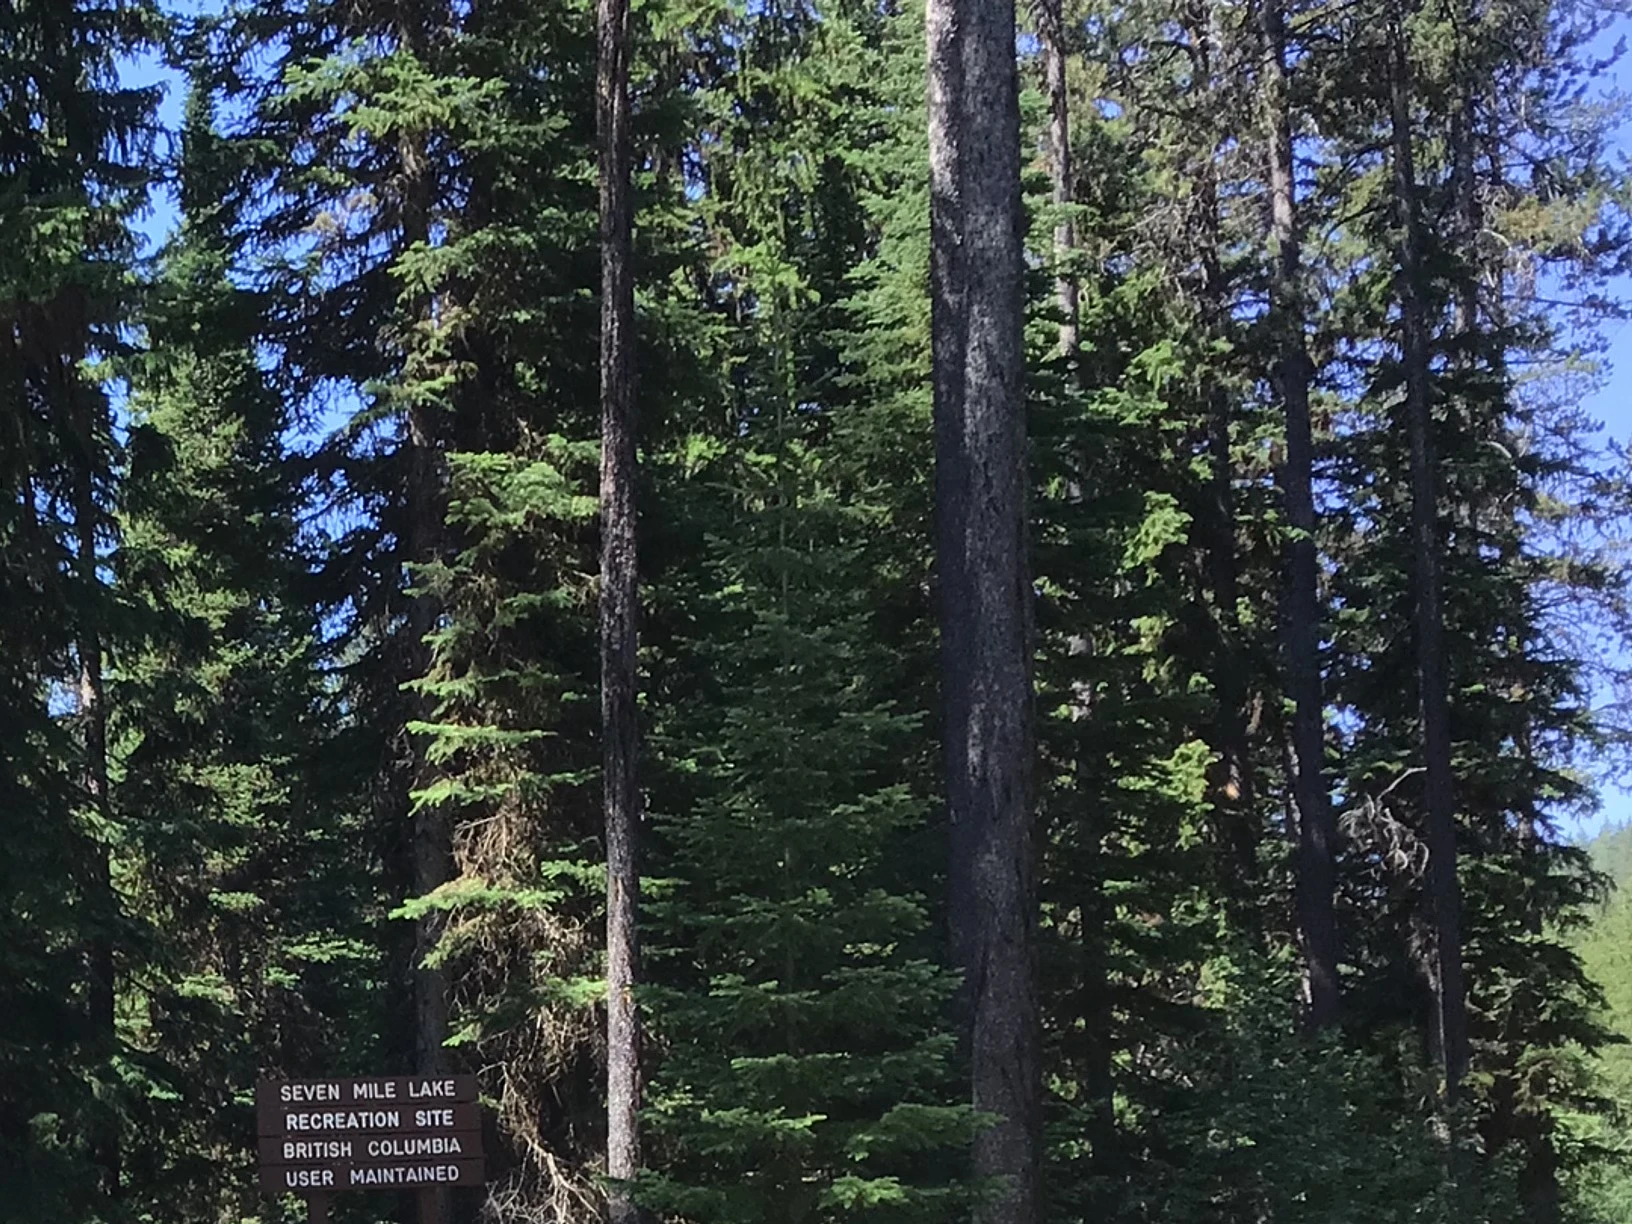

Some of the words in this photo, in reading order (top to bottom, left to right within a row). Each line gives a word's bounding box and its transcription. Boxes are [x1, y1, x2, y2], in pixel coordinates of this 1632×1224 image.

[280, 1084, 340, 1102] SEVEN
[353, 1081, 396, 1099] MILE
[408, 1080, 456, 1098] LAKE
[285, 1111, 400, 1130] RECREATION
[415, 1109, 454, 1127] SITE
[283, 1141, 352, 1159] BRITISH
[368, 1137, 462, 1156] COLUMBIA
[286, 1169, 334, 1187] USER
[350, 1165, 460, 1185] MAINTAINED
